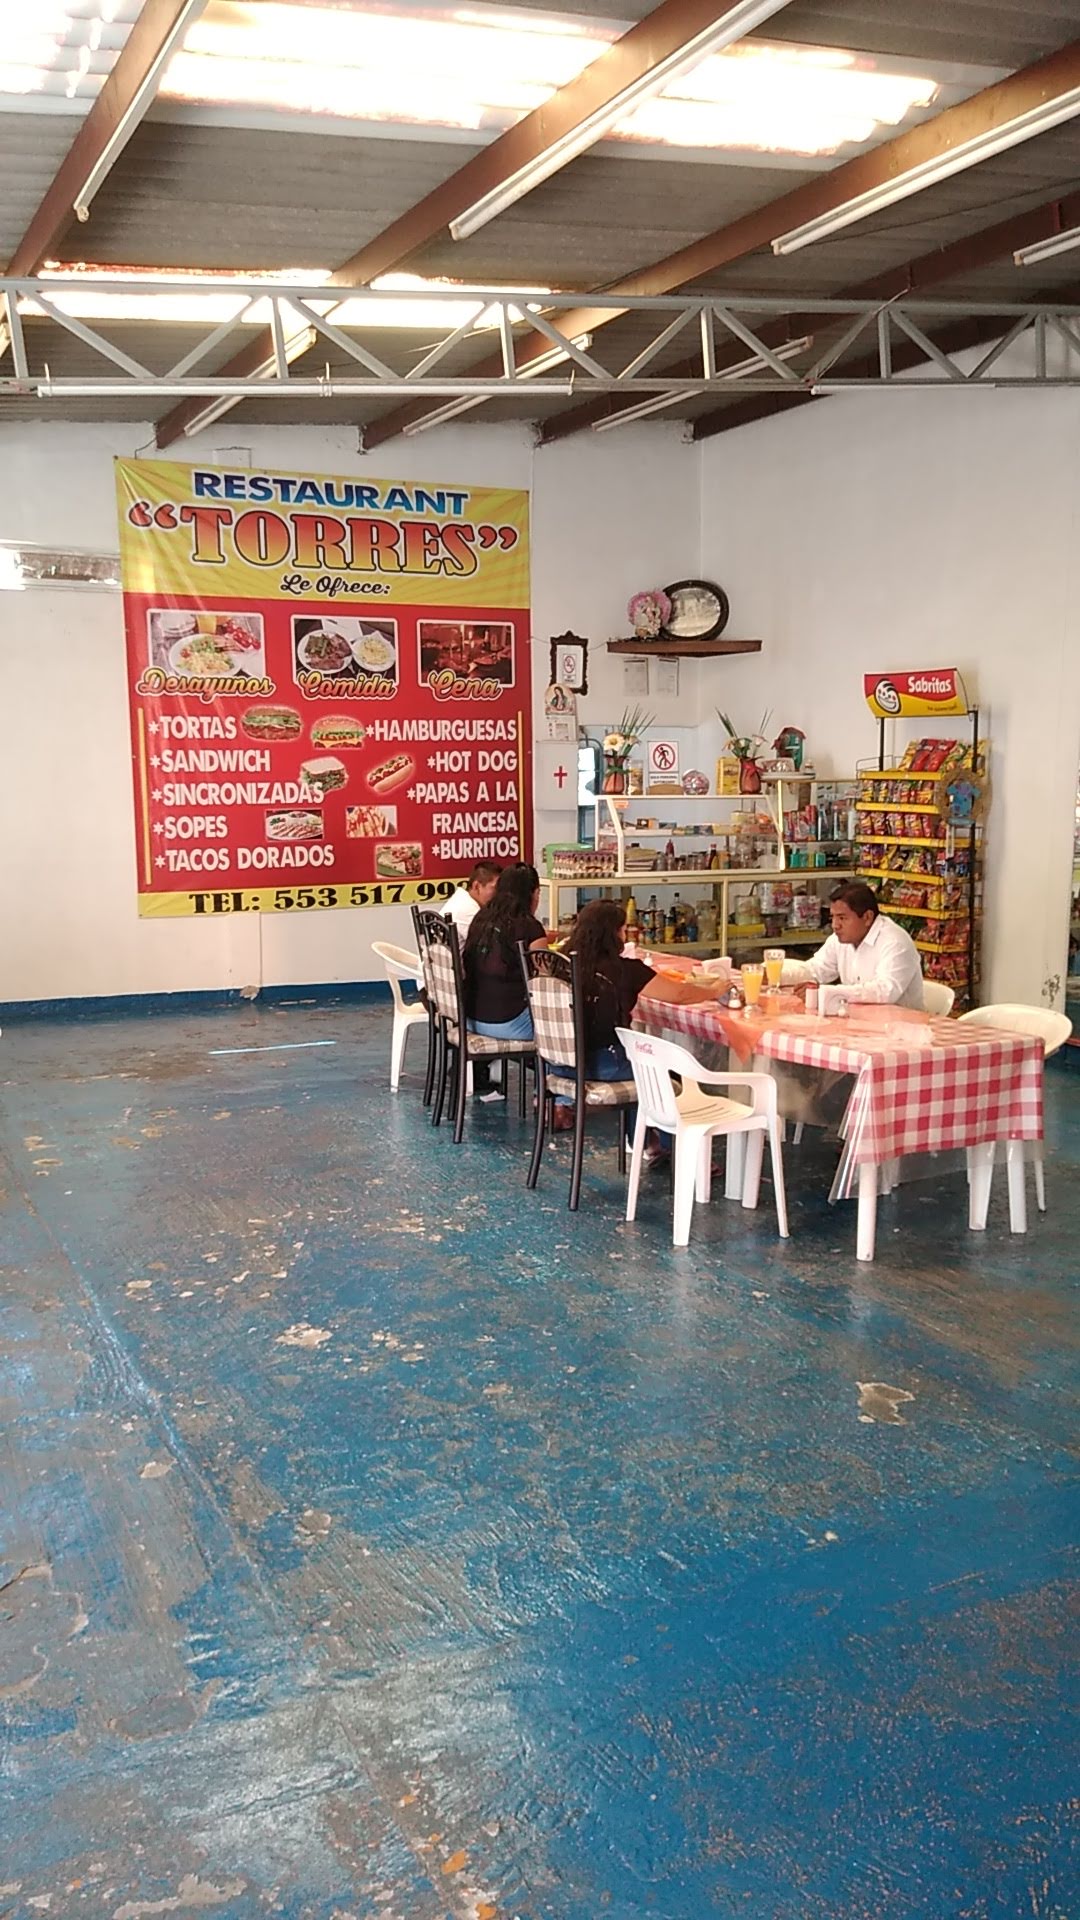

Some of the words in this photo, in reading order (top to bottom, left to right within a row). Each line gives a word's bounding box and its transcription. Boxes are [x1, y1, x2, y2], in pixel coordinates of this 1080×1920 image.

[195, 472, 468, 515] RESTAURANT
[281, 574, 312, 594] Le
[314, 577, 391, 597] Ofrece:
[138, 667, 273, 701] Desayunos
[300, 671, 396, 698] Comida
[430, 670, 504, 699] Cena
[907, 675, 952, 694] Sabritas
[478, 750, 517, 771] DOG
[476, 781, 490, 802] A
[496, 780, 517, 802] LA
[432, 811, 518, 834] FRANCESA
[237, 844, 335, 870] DORADOS
[189, 891, 261, 916] TEL:
[274, 887, 339, 911] 553
[350, 883, 405, 907] 517
